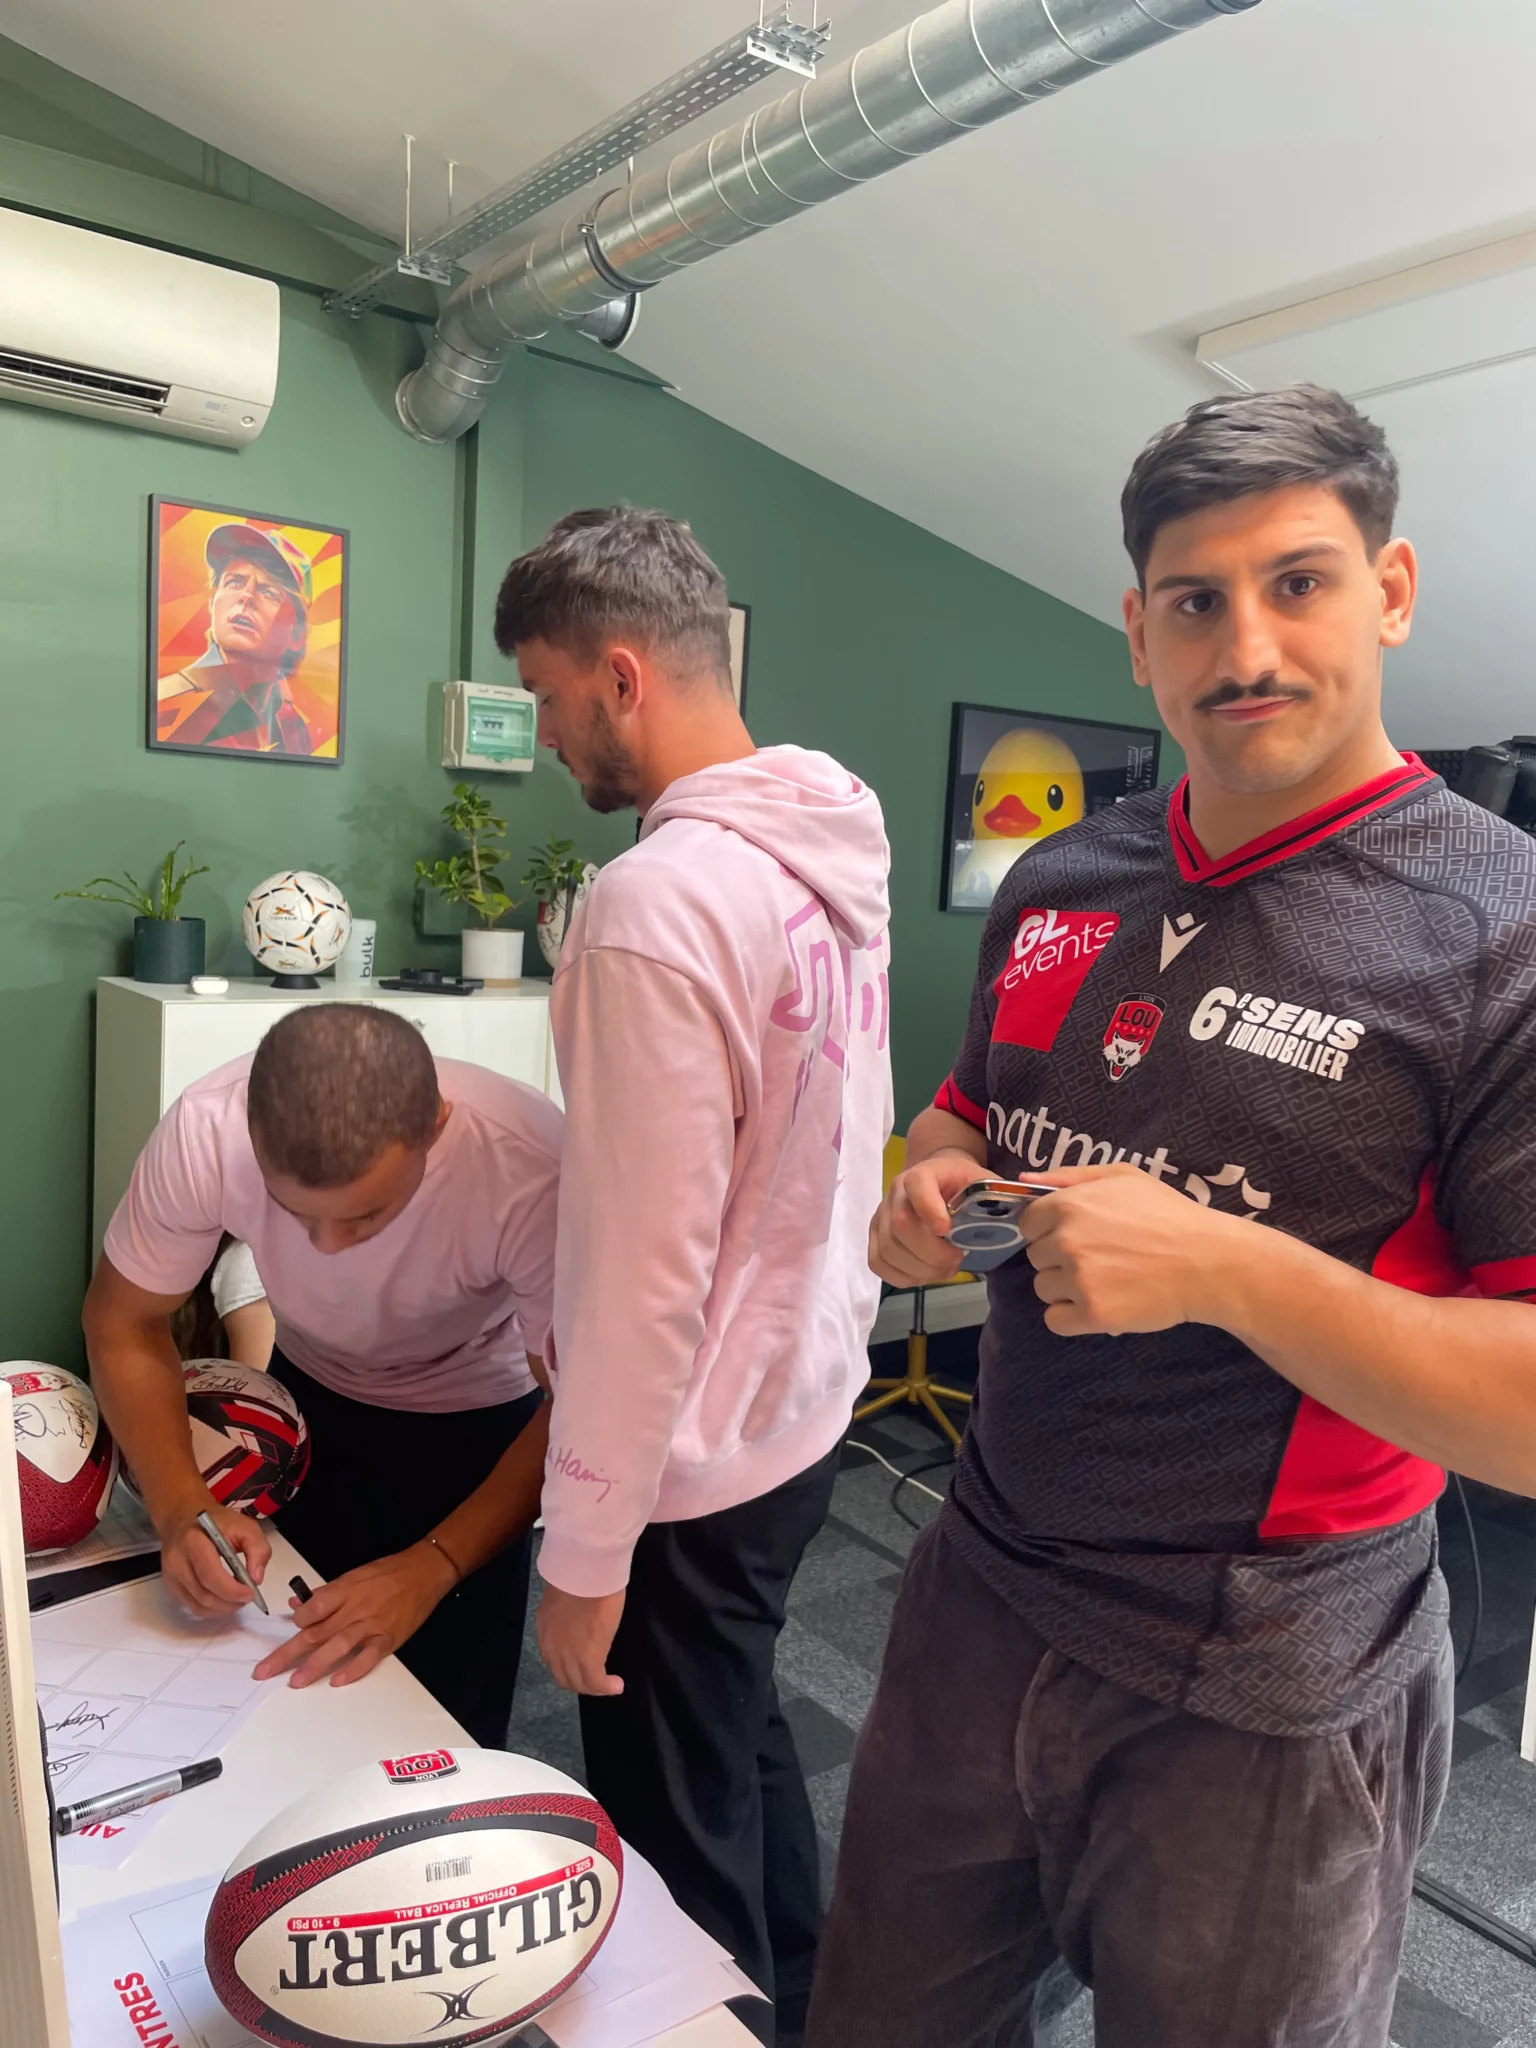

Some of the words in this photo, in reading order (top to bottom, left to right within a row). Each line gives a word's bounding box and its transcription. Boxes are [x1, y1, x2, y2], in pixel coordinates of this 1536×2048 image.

[1014, 909, 1069, 959] GL
[360, 936, 374, 978] bulk
[1004, 921, 1115, 990] events
[1119, 1004, 1158, 1029] LOU
[1224, 1020, 1349, 1082] IMMOBILIER
[394, 1755, 449, 1776] LOU
[415, 1772, 439, 1781] LYON
[425, 1900, 470, 1914] REPLICA
[472, 1886, 517, 1905] OFFICIAL
[292, 1919, 309, 1930] PSI
[394, 1907, 423, 1920] BALL
[278, 1871, 601, 1990] GILBERT
